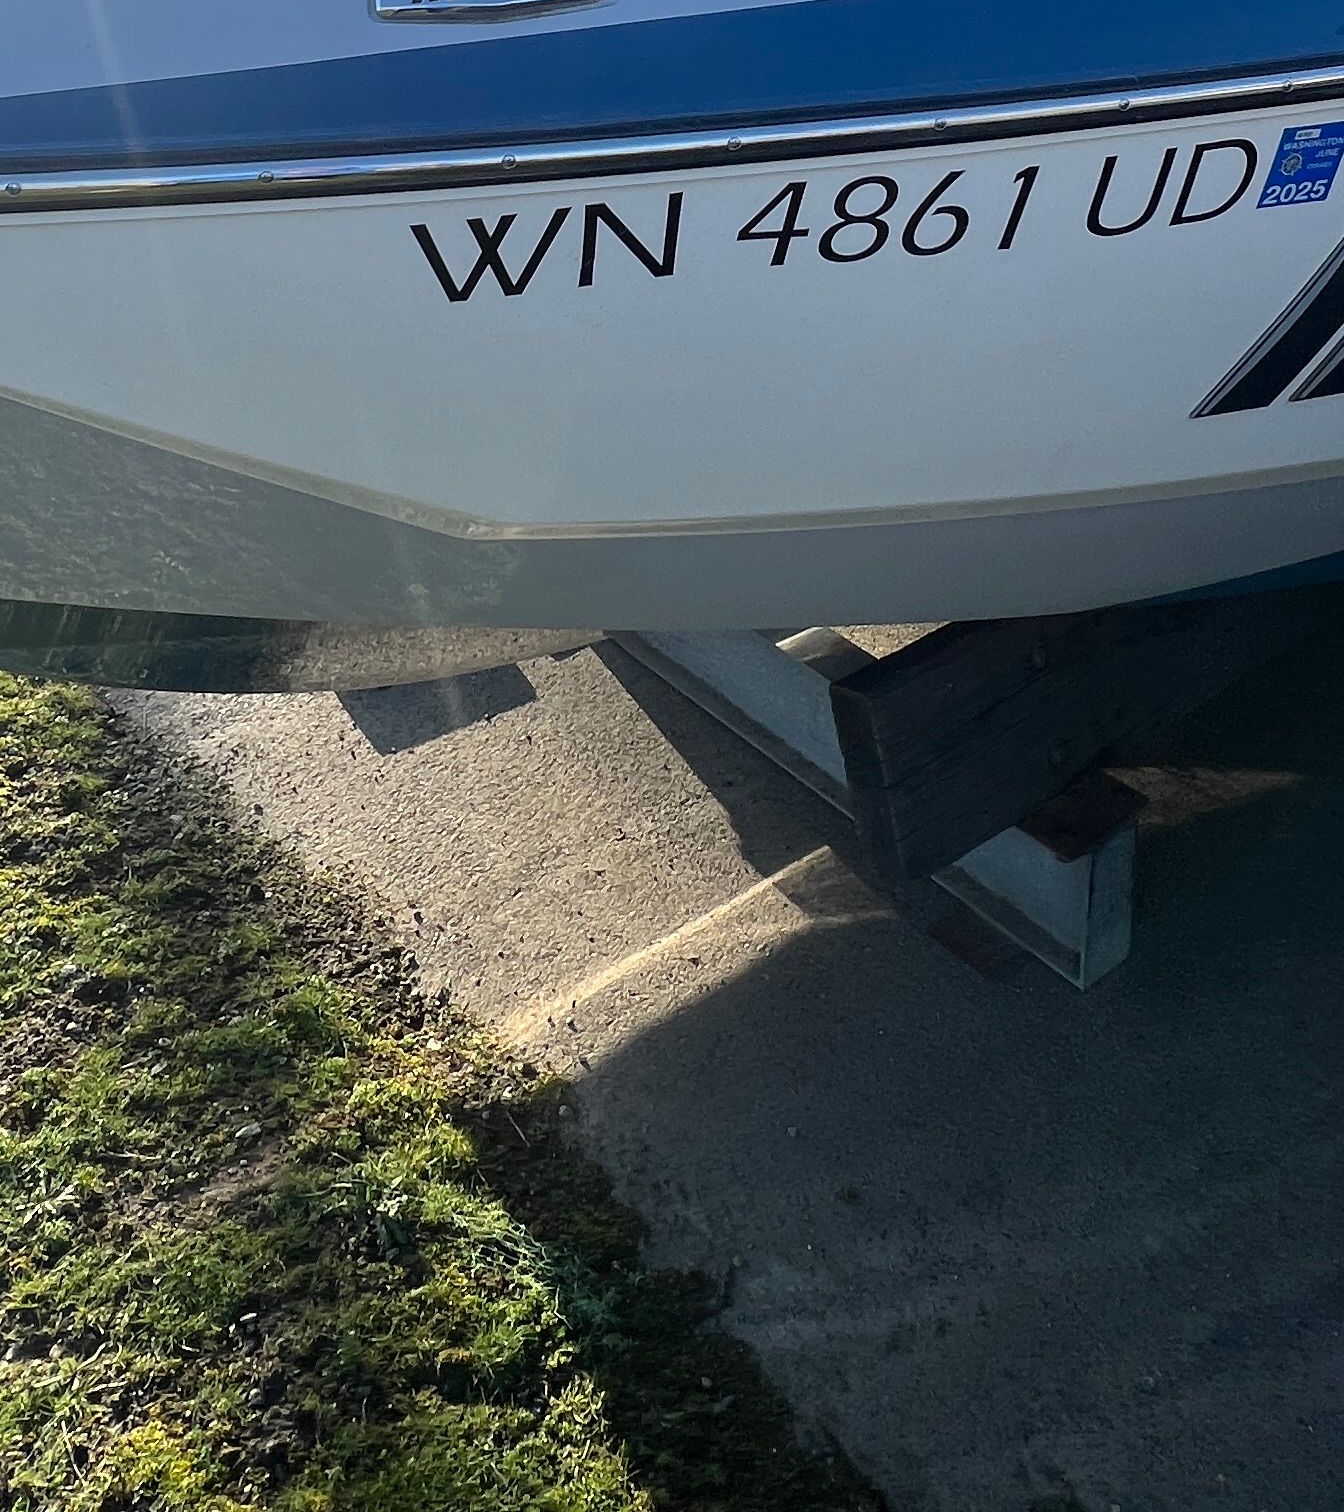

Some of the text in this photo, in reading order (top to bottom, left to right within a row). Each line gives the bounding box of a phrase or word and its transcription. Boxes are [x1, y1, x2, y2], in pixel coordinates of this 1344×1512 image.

[410, 138, 1258, 303] WN 4861 UD
[1261, 179, 1329, 205] 2025
